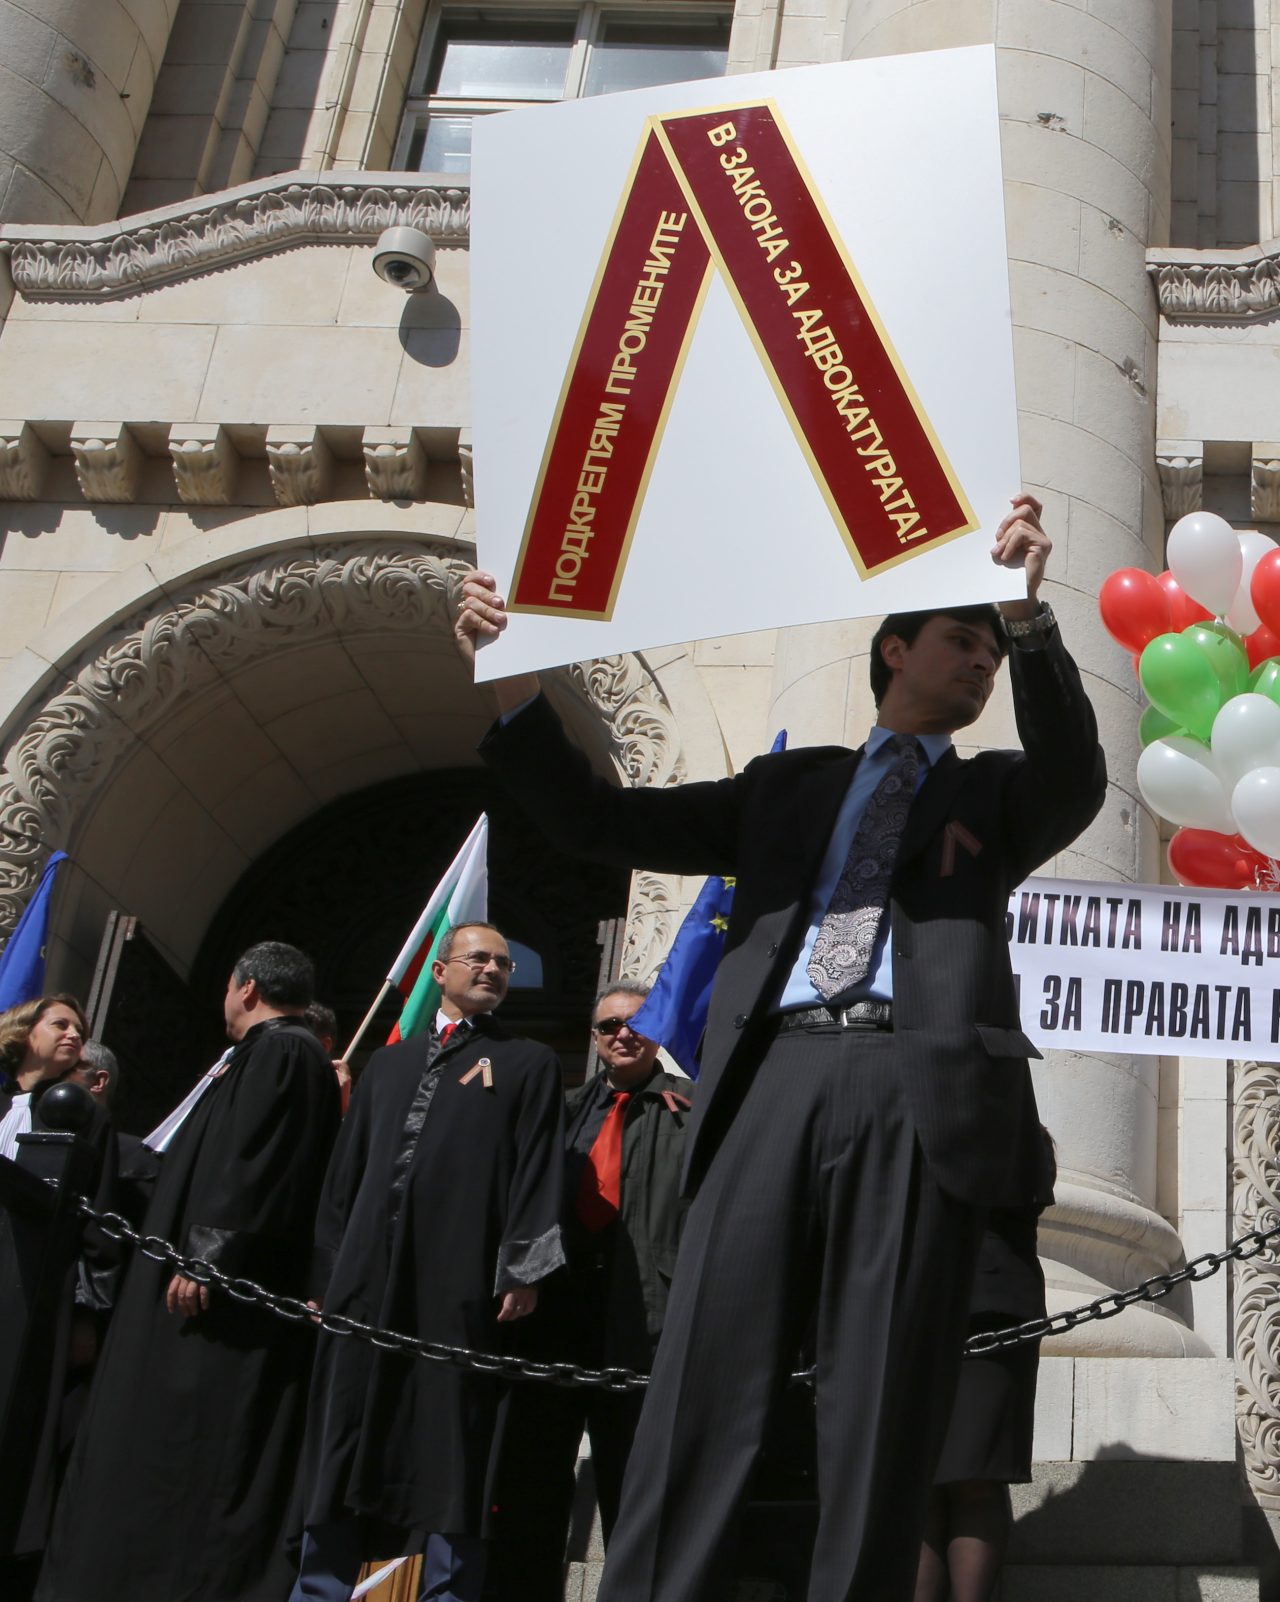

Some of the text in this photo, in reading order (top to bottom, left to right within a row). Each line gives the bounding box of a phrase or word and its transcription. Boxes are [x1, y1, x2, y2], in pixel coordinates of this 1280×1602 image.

[549, 210, 687, 602] ПОДКРЕПЯМ ПРОМЕНИТЕ
[707, 121, 928, 544] В ЗАКОНА ЗА АДВОКАТУРАТА!
[1040, 975, 1082, 1031] ЗА
[1101, 978, 1251, 1042] ПРАВАТА
[1161, 901, 1201, 953] НА
